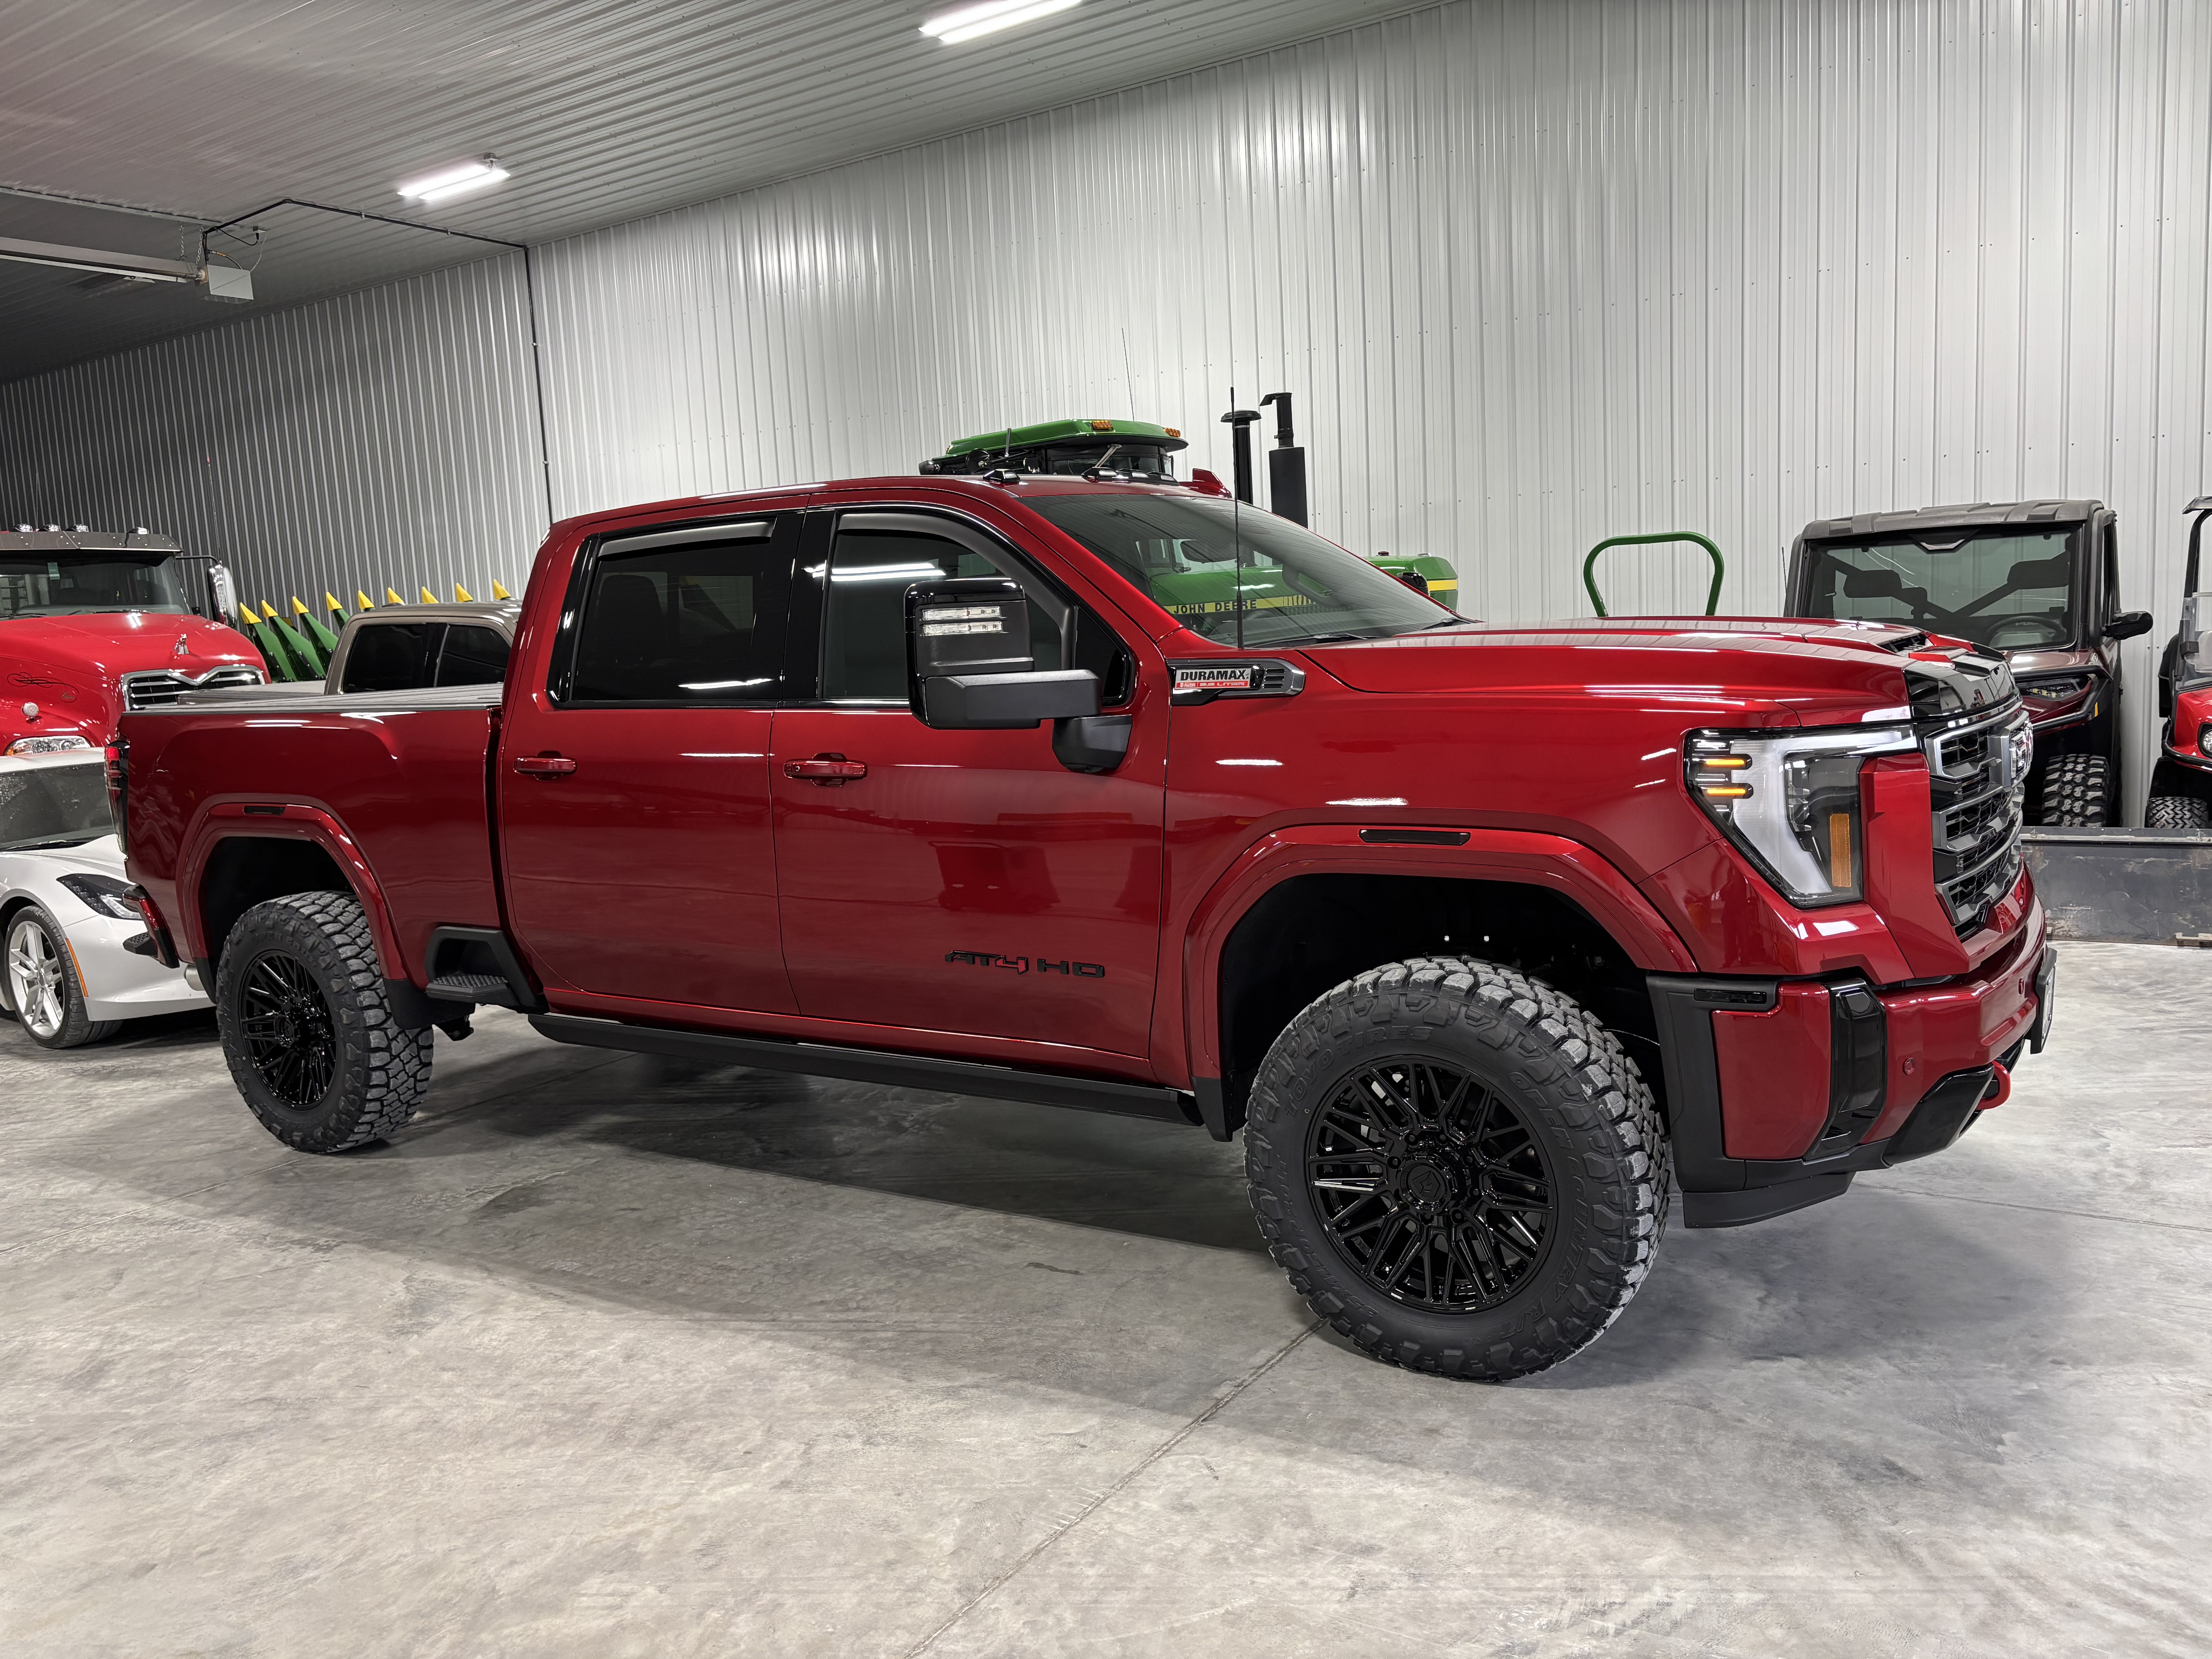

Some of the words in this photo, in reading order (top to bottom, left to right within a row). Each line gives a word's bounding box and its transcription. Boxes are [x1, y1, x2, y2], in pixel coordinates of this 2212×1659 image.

[1174, 604, 1205, 614] JOHN
[1215, 599, 1257, 611] DEERE
[1181, 670, 1246, 681] DURAMAX
[945, 950, 1029, 974] AT4
[1037, 958, 1105, 977] HD
[1284, 1049, 1334, 1117] TOYO
[1336, 1025, 1434, 1055] TIRES
[1509, 1072, 1574, 1149] OPEN
[1554, 1156, 1588, 1302] COUNTRY
